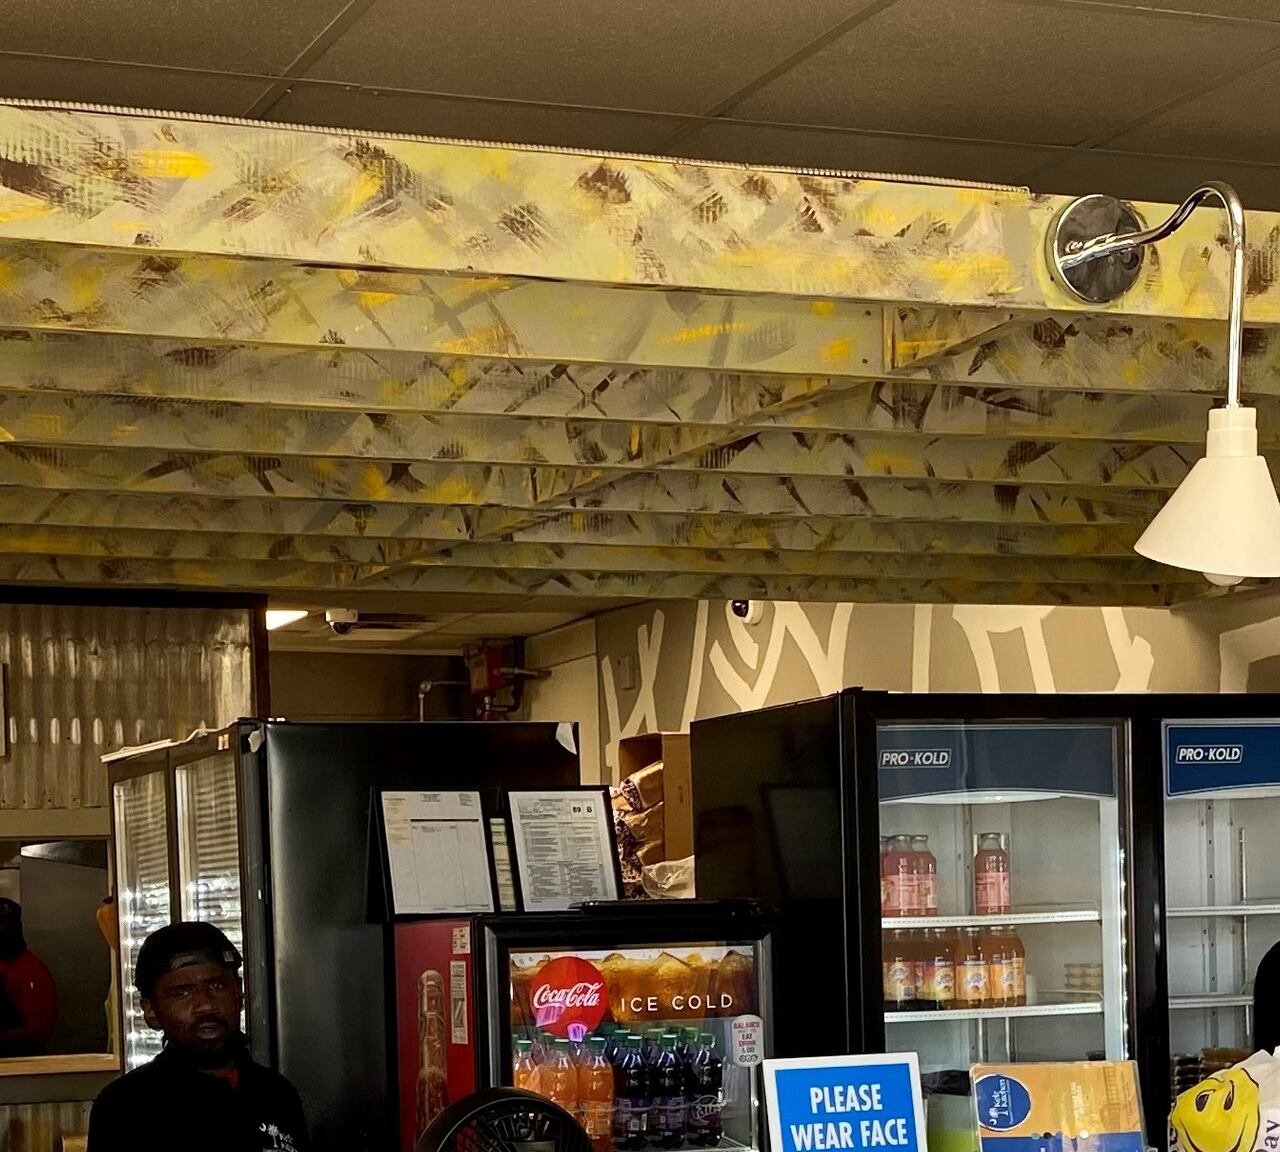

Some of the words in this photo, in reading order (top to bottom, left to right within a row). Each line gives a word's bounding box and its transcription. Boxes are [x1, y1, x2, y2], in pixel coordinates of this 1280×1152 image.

[621, 996, 659, 1013] ICE
[671, 993, 733, 1010] COLD
[809, 1083, 883, 1114] PLEASE
[790, 1122, 854, 1152] WEAR
[859, 1118, 908, 1148] FACE
